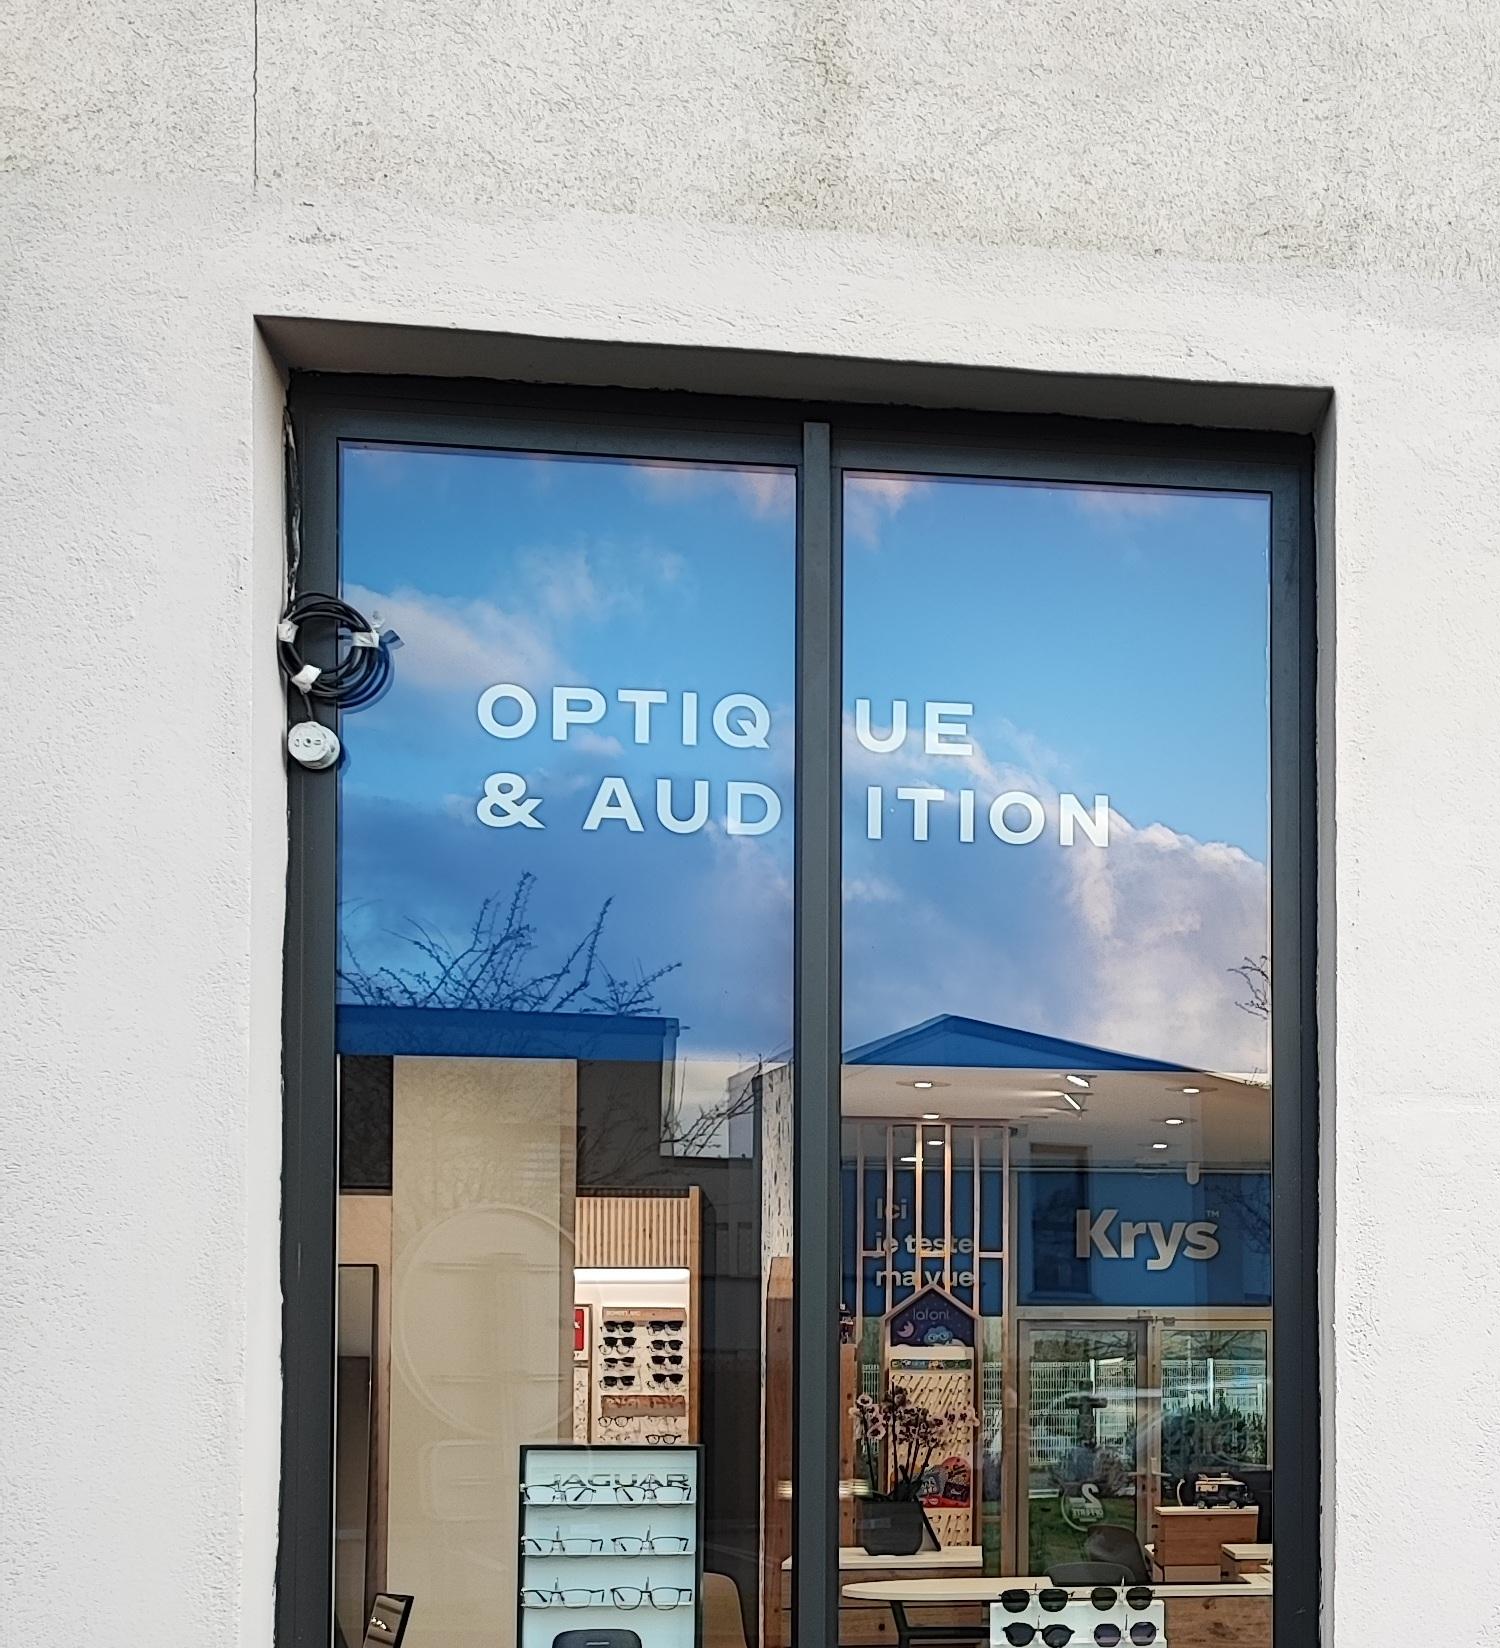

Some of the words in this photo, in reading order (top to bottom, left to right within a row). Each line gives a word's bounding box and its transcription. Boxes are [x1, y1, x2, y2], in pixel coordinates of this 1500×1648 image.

[476, 771, 544, 829] &
[876, 1198, 907, 1220] Ici
[905, 1234, 974, 1254] teste
[1076, 1209, 1220, 1271] Krys
[876, 1270, 917, 1287] ma
[924, 1270, 975, 1287] vue
[553, 1473, 690, 1487] JAGUAR
